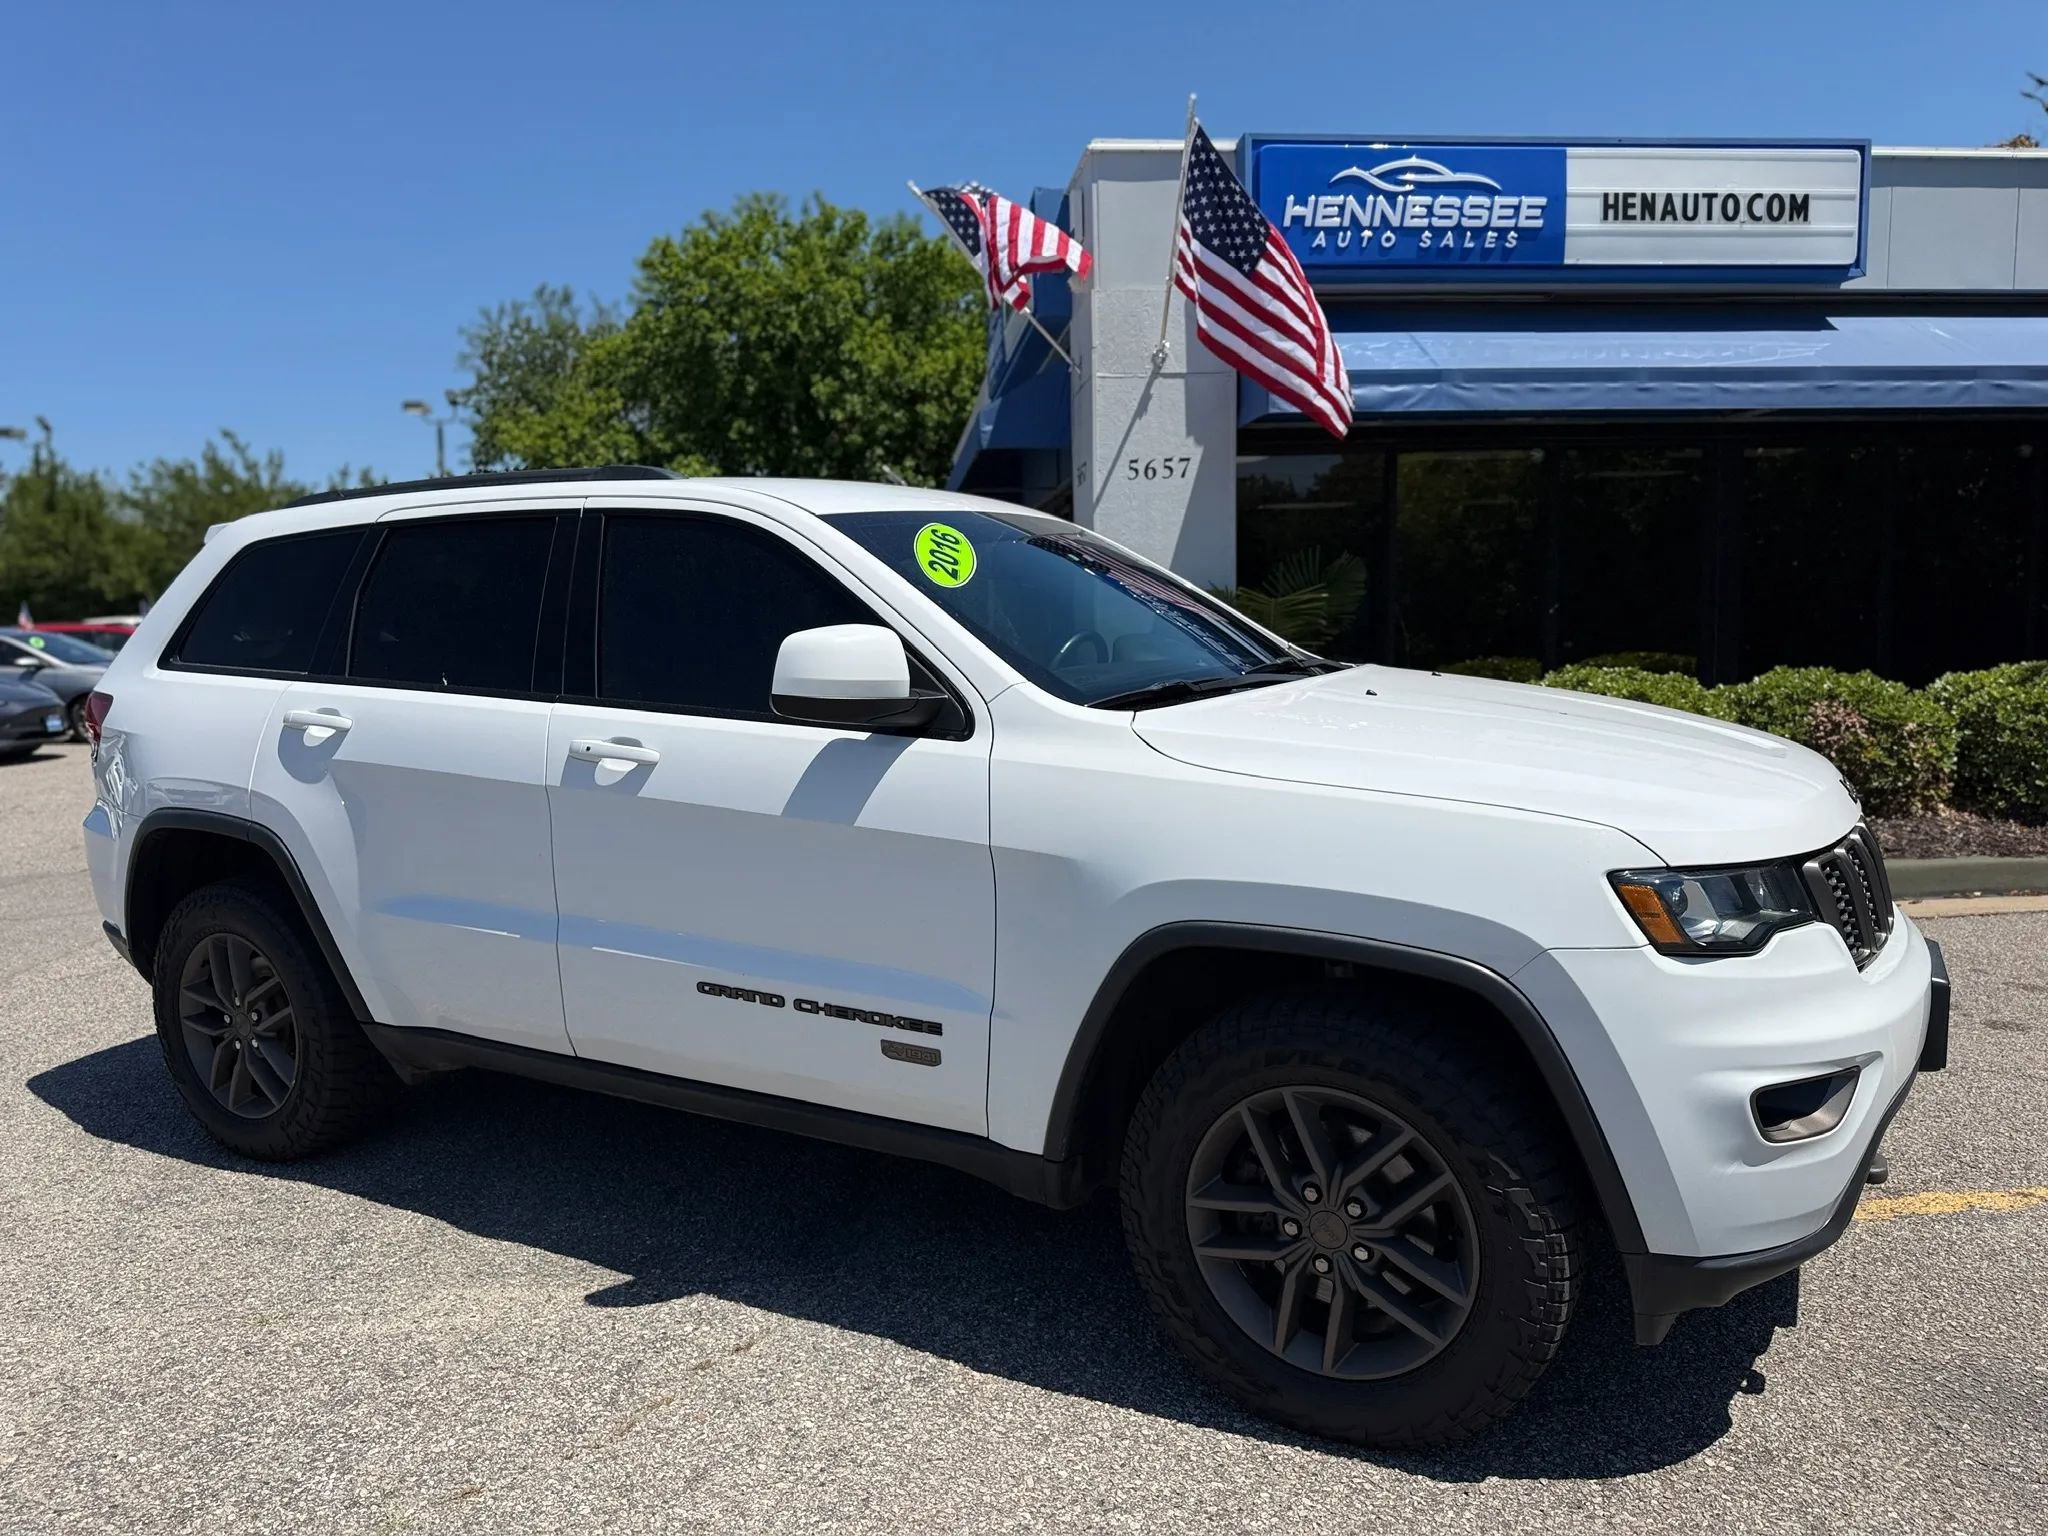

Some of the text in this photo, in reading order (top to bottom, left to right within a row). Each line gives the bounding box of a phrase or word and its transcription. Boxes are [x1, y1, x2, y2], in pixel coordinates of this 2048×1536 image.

[1283, 194, 1548, 228] HENNESSEE
[1312, 230, 1519, 248] AUTO SALES
[1127, 457, 1192, 481] 5657
[928, 528, 961, 581] 2016
[696, 981, 943, 1036] GRAND CHEROKEE
